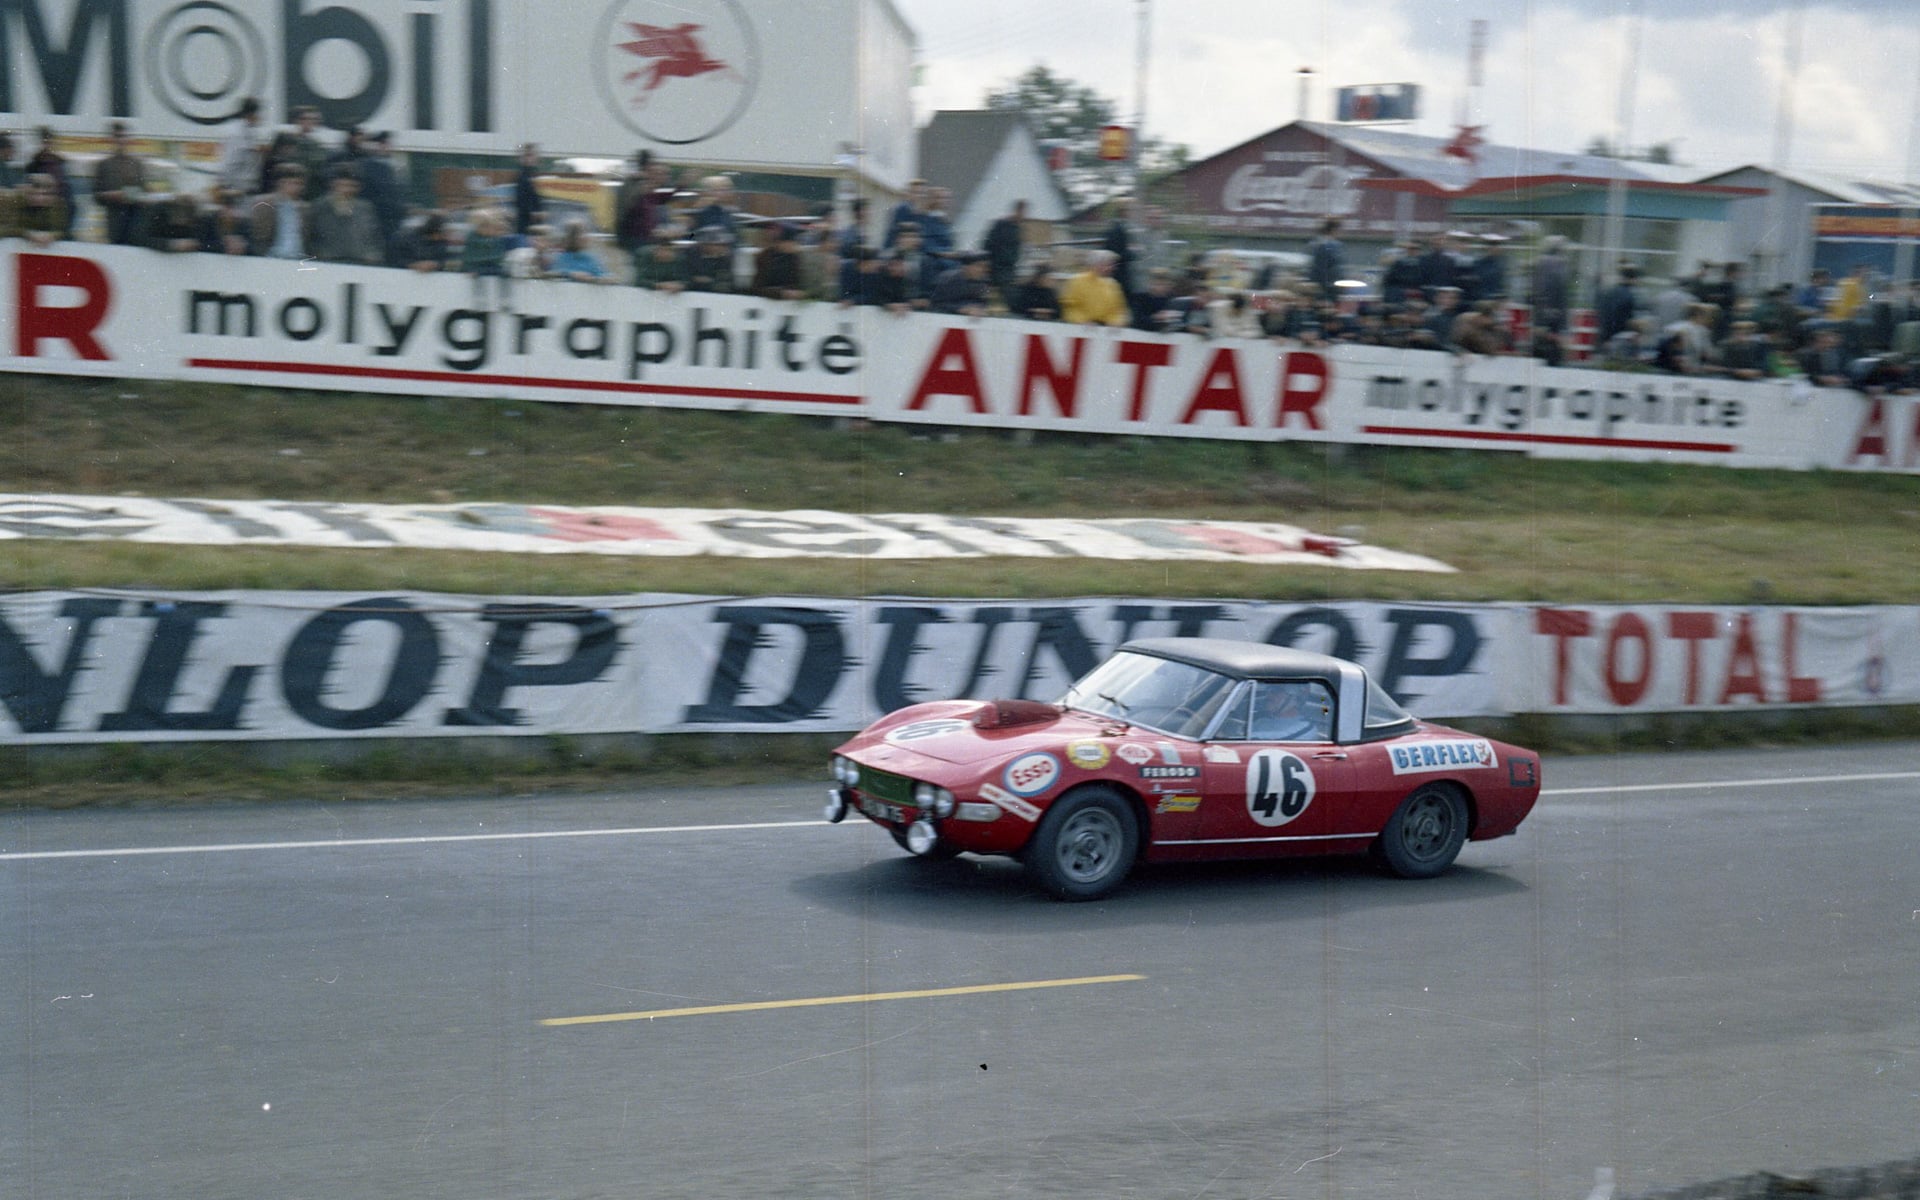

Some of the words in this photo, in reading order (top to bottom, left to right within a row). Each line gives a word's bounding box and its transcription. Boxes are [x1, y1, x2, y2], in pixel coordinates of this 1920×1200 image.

[0, 0, 495, 132] Mobil
[12, 252, 116, 361] R
[188, 283, 861, 379] molygraphite
[905, 328, 1330, 431] ANTAR
[1366, 366, 1746, 438] molygraphite
[1535, 607, 1822, 706] TOTAL
[1011, 759, 1052, 788] ESSO
[1143, 767, 1196, 777] FERODO
[1252, 754, 1308, 818] 46
[1395, 742, 1480, 769] GERFLEX
